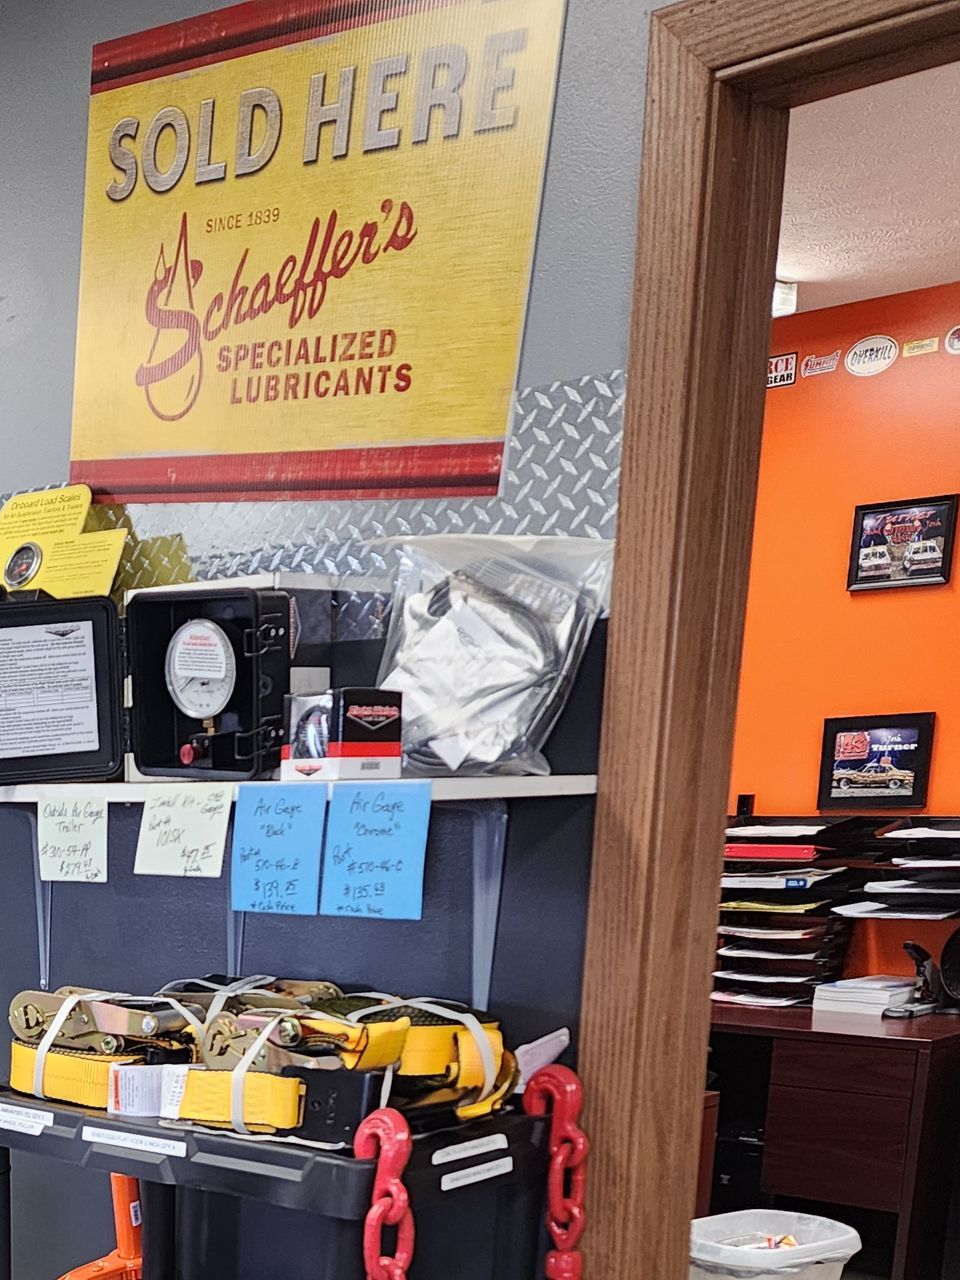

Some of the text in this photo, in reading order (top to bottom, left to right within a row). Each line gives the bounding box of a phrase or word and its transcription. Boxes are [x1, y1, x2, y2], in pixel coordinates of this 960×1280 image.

[106, 28, 529, 203] SOLD HERE
[205, 207, 281, 234] SINCE 1839
[135, 199, 418, 388] Schaeffer's
[216, 329, 397, 374] SPECIALIZED
[230, 363, 414, 405] LUBRICANTS
[11, 494, 81, 511] Onboard Load Scales
